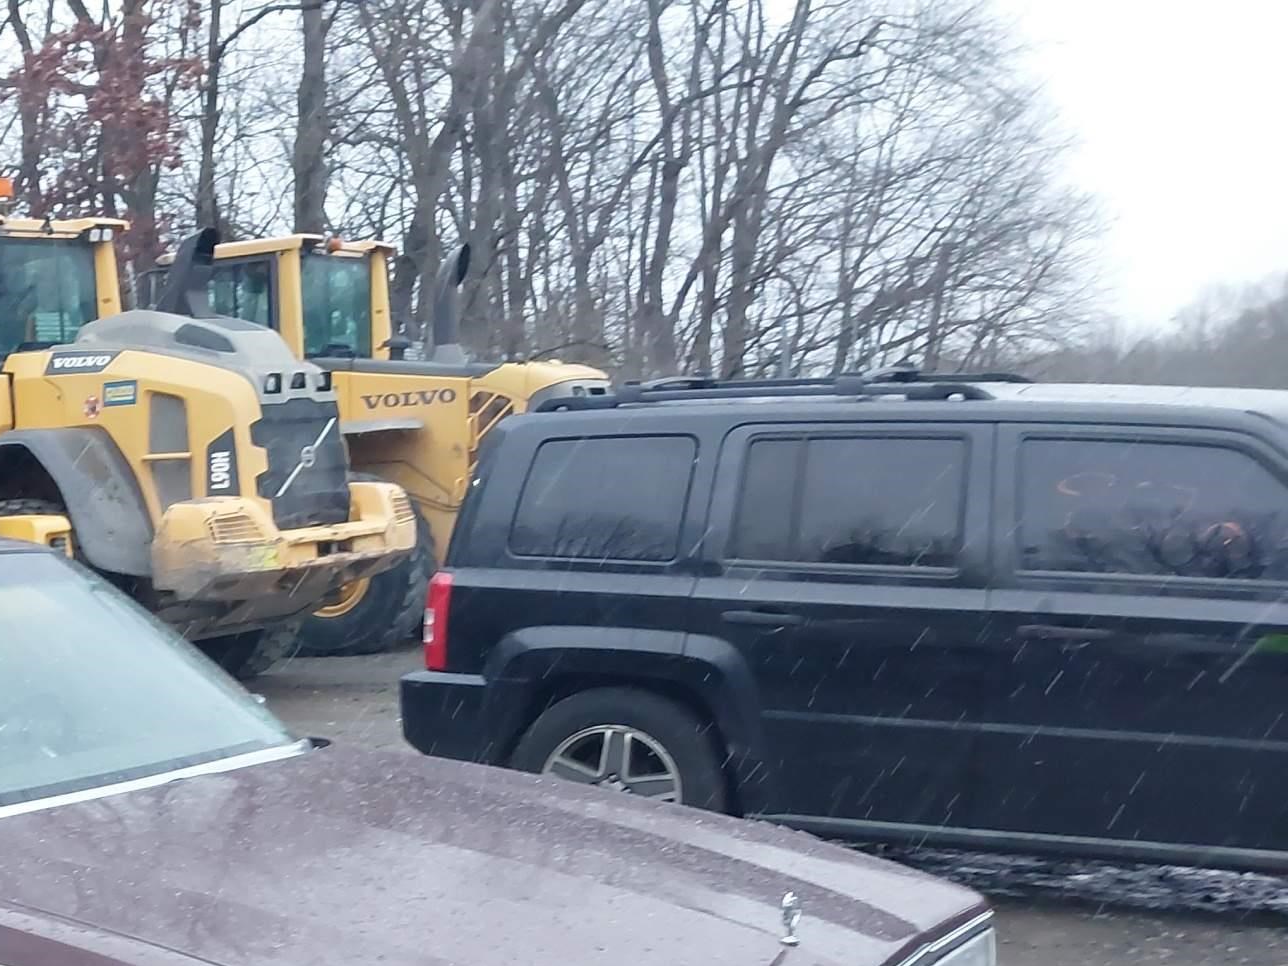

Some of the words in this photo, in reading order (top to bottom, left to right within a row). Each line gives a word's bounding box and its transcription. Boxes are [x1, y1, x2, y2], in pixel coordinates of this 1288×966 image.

[53, 355, 112, 369] VOLVO
[360, 388, 456, 409] VOLVO
[210, 451, 231, 490] L90H
